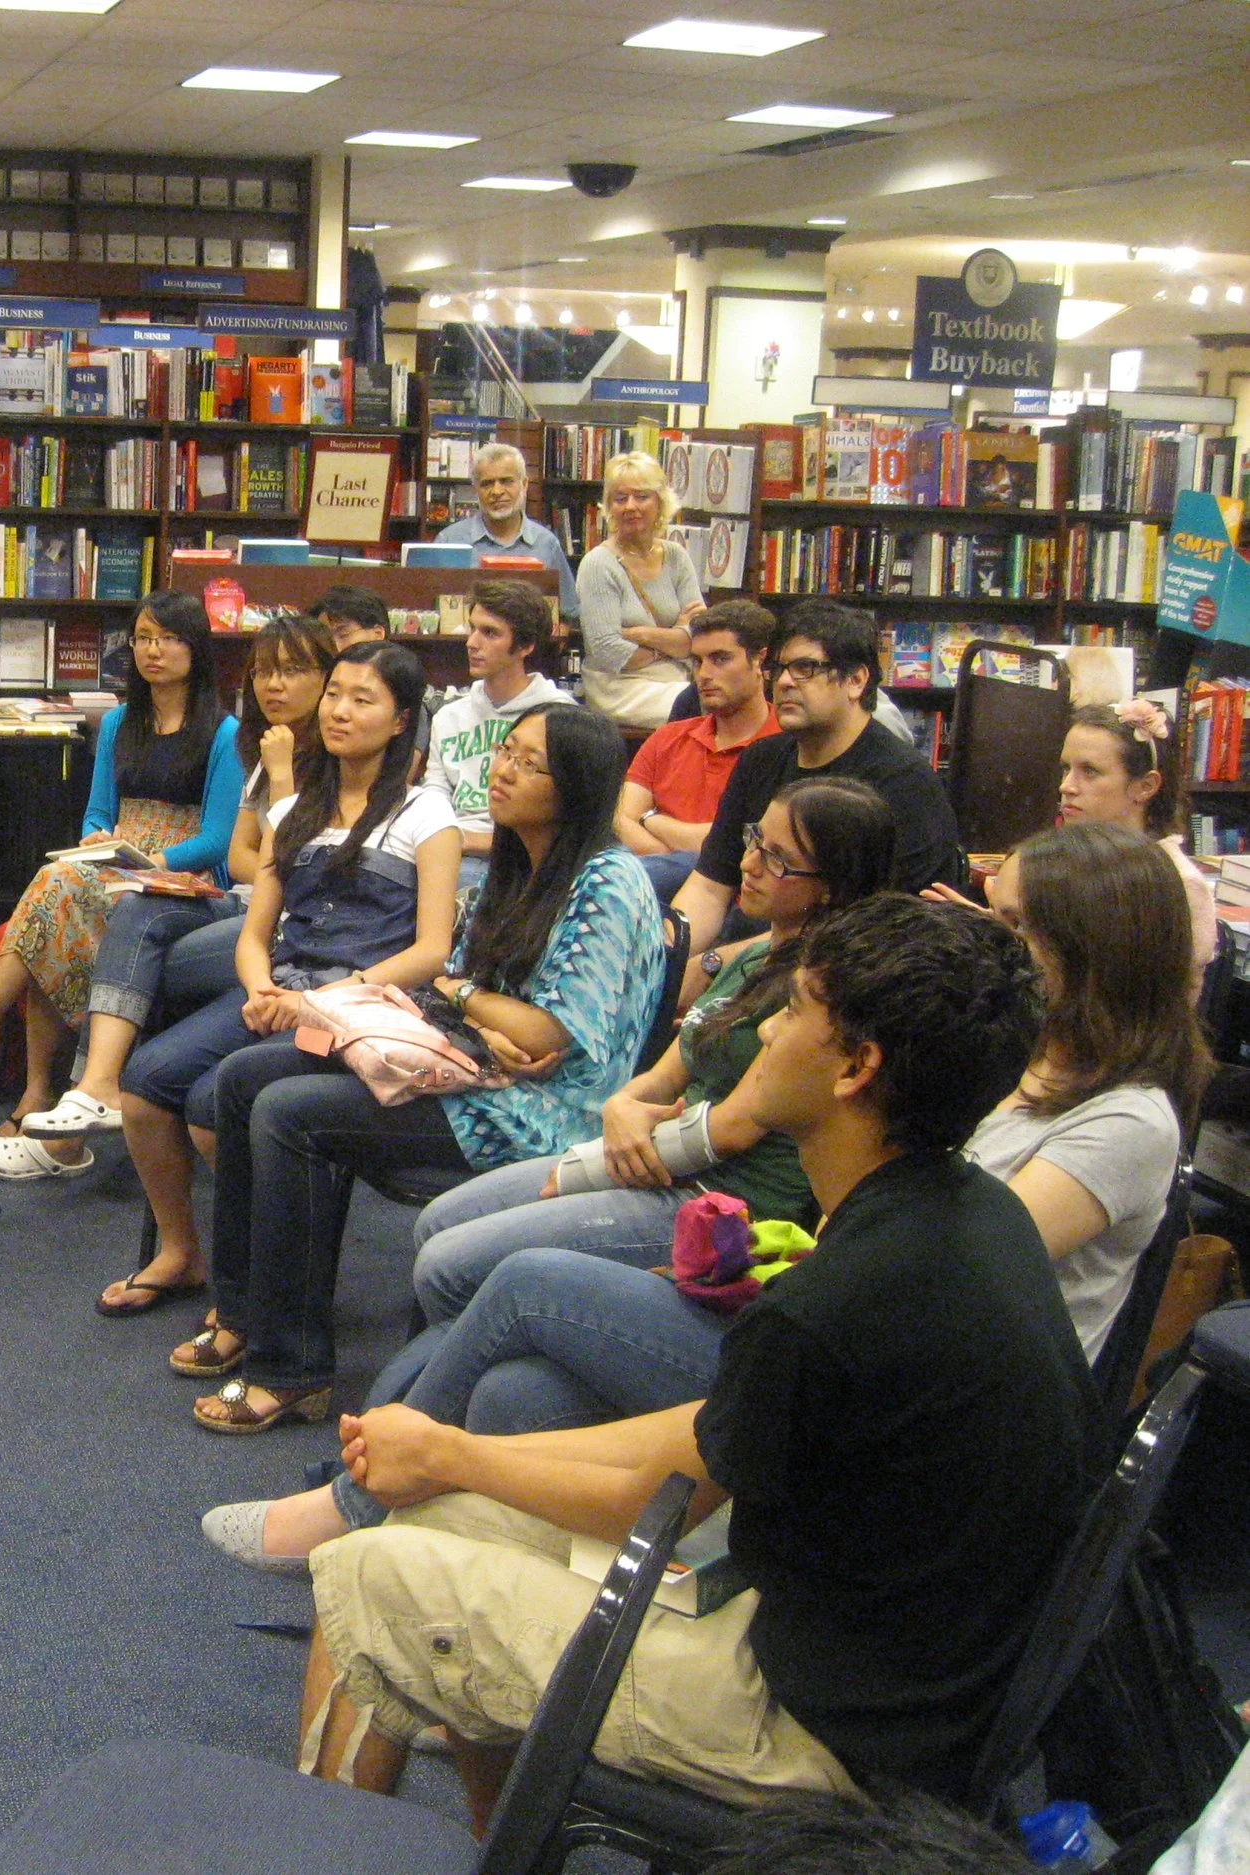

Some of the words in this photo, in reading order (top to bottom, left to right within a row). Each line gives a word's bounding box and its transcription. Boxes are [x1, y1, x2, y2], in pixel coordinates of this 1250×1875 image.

[205, 315, 348, 332] ADVERTISING/FUNDRAISING
[928, 311, 1045, 343] Textbook
[133, 330, 171, 341] BUSINESS
[257, 361, 298, 371] HEGARTY
[928, 346, 1040, 380] Buyback
[620, 384, 680, 397] ANTHROPOLOGY
[357, 440, 381, 449] Priced
[825, 435, 871, 446] NIMALS
[250, 470, 284, 481] ALES
[249, 482, 284, 491] ROWTH
[333, 473, 367, 491] Last
[250, 491, 283, 499] PERATIVE
[316, 489, 380, 508] Chance
[1172, 532, 1229, 563] GMAT
[101, 558, 139, 566] ECONOMY
[59, 650, 97, 661] WORLD
